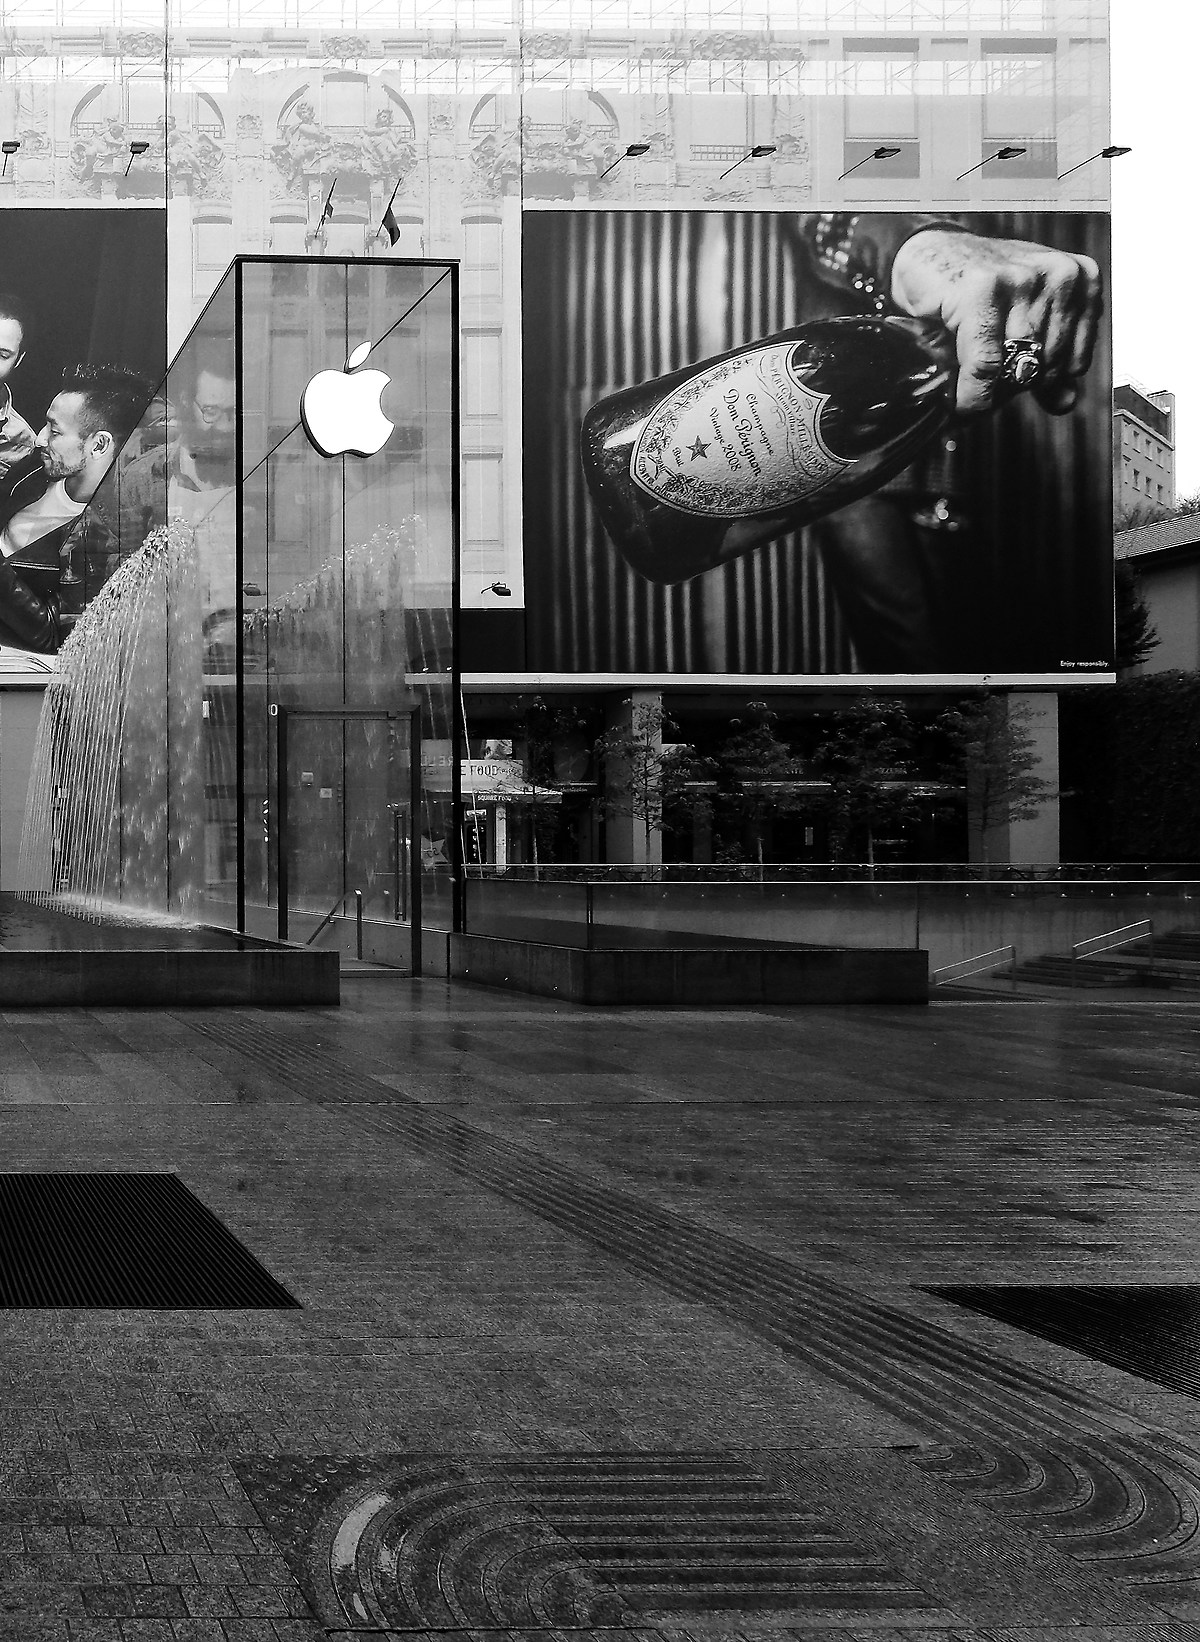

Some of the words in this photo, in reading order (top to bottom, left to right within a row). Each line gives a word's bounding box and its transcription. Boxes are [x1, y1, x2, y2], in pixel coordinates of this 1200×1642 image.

[710, 407, 725, 445] Vintage
[722, 443, 741, 472] 2008
[723, 388, 740, 421] Dom
[735, 418, 762, 477] Pérignon
[746, 393, 774, 456] Champagne
[672, 447, 684, 467] Brut
